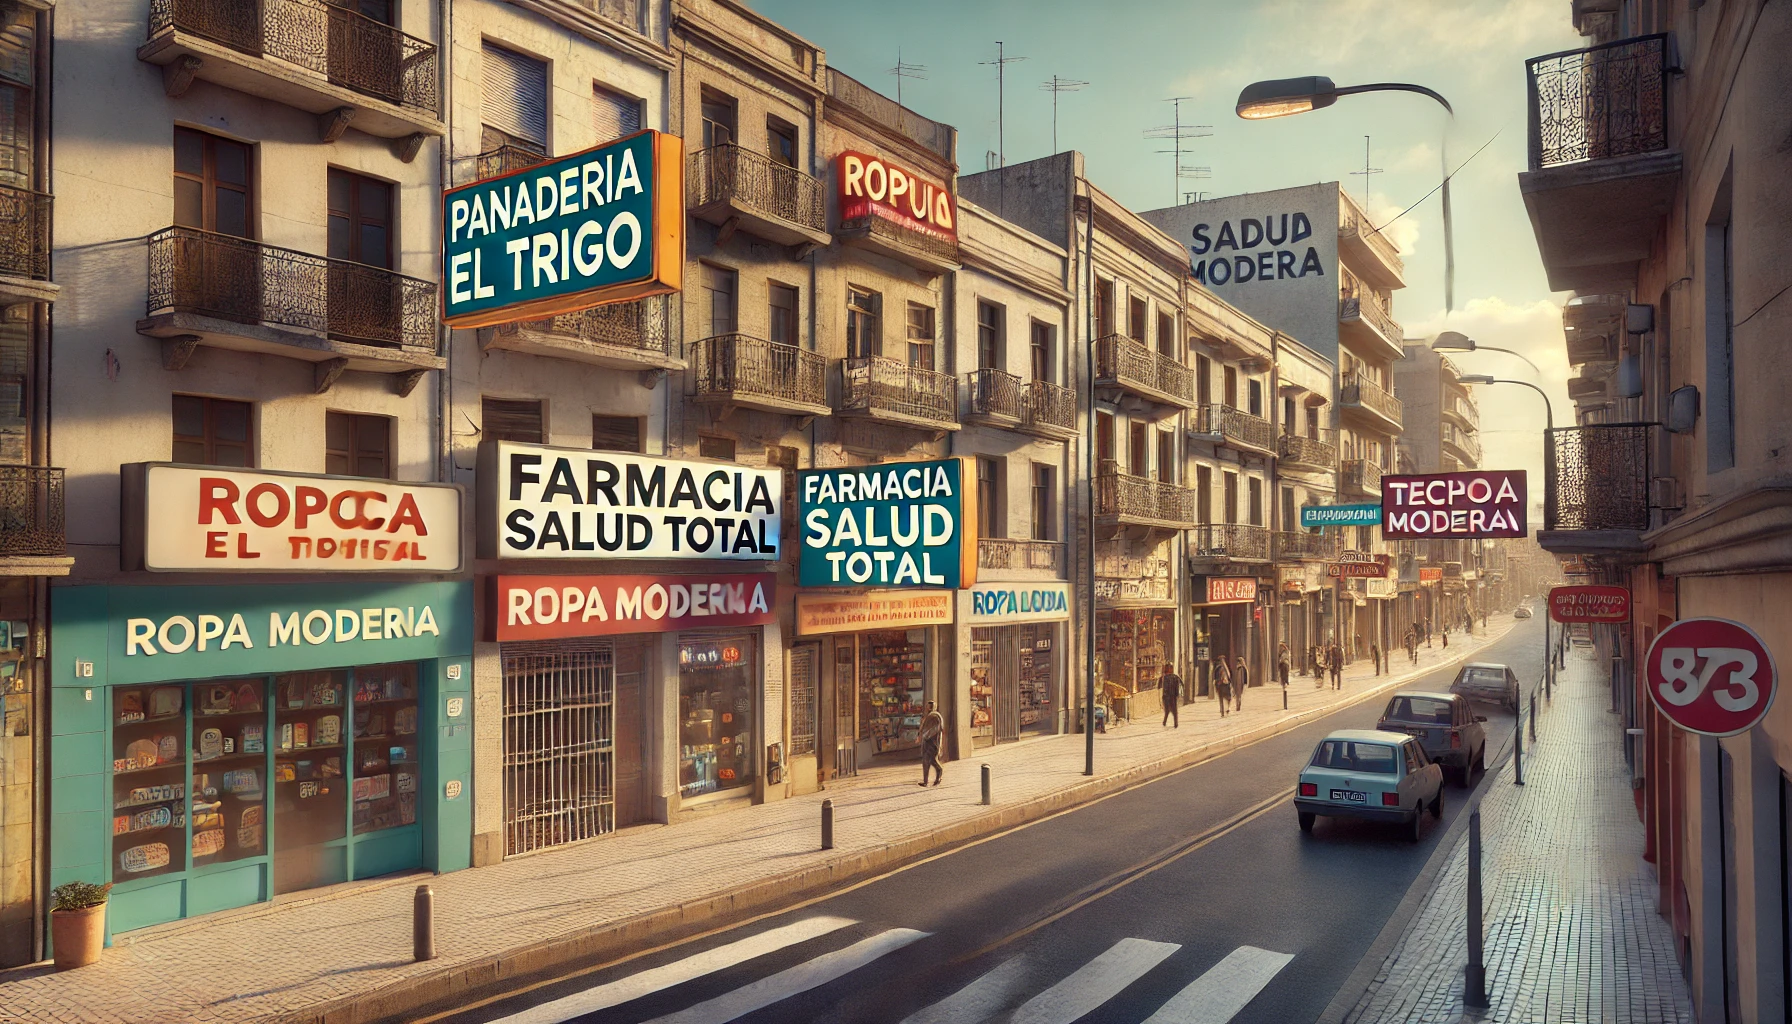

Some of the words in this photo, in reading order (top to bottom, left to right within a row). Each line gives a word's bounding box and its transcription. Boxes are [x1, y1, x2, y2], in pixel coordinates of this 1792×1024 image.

[451, 147, 645, 243] PANADERIA
[451, 247, 495, 304] EL
[506, 210, 643, 291] TRIGO
[509, 453, 775, 515] FARMACIA
[804, 465, 953, 504] FARMACIA
[205, 531, 261, 559] EL
[505, 508, 653, 552] SALUD
[663, 515, 777, 555] TOTAL
[804, 503, 955, 549] SALUD
[824, 550, 946, 586] TOTAL
[508, 585, 608, 626] ROPA
[126, 613, 254, 656] ROPA
[1658, 646, 1760, 713] 873
